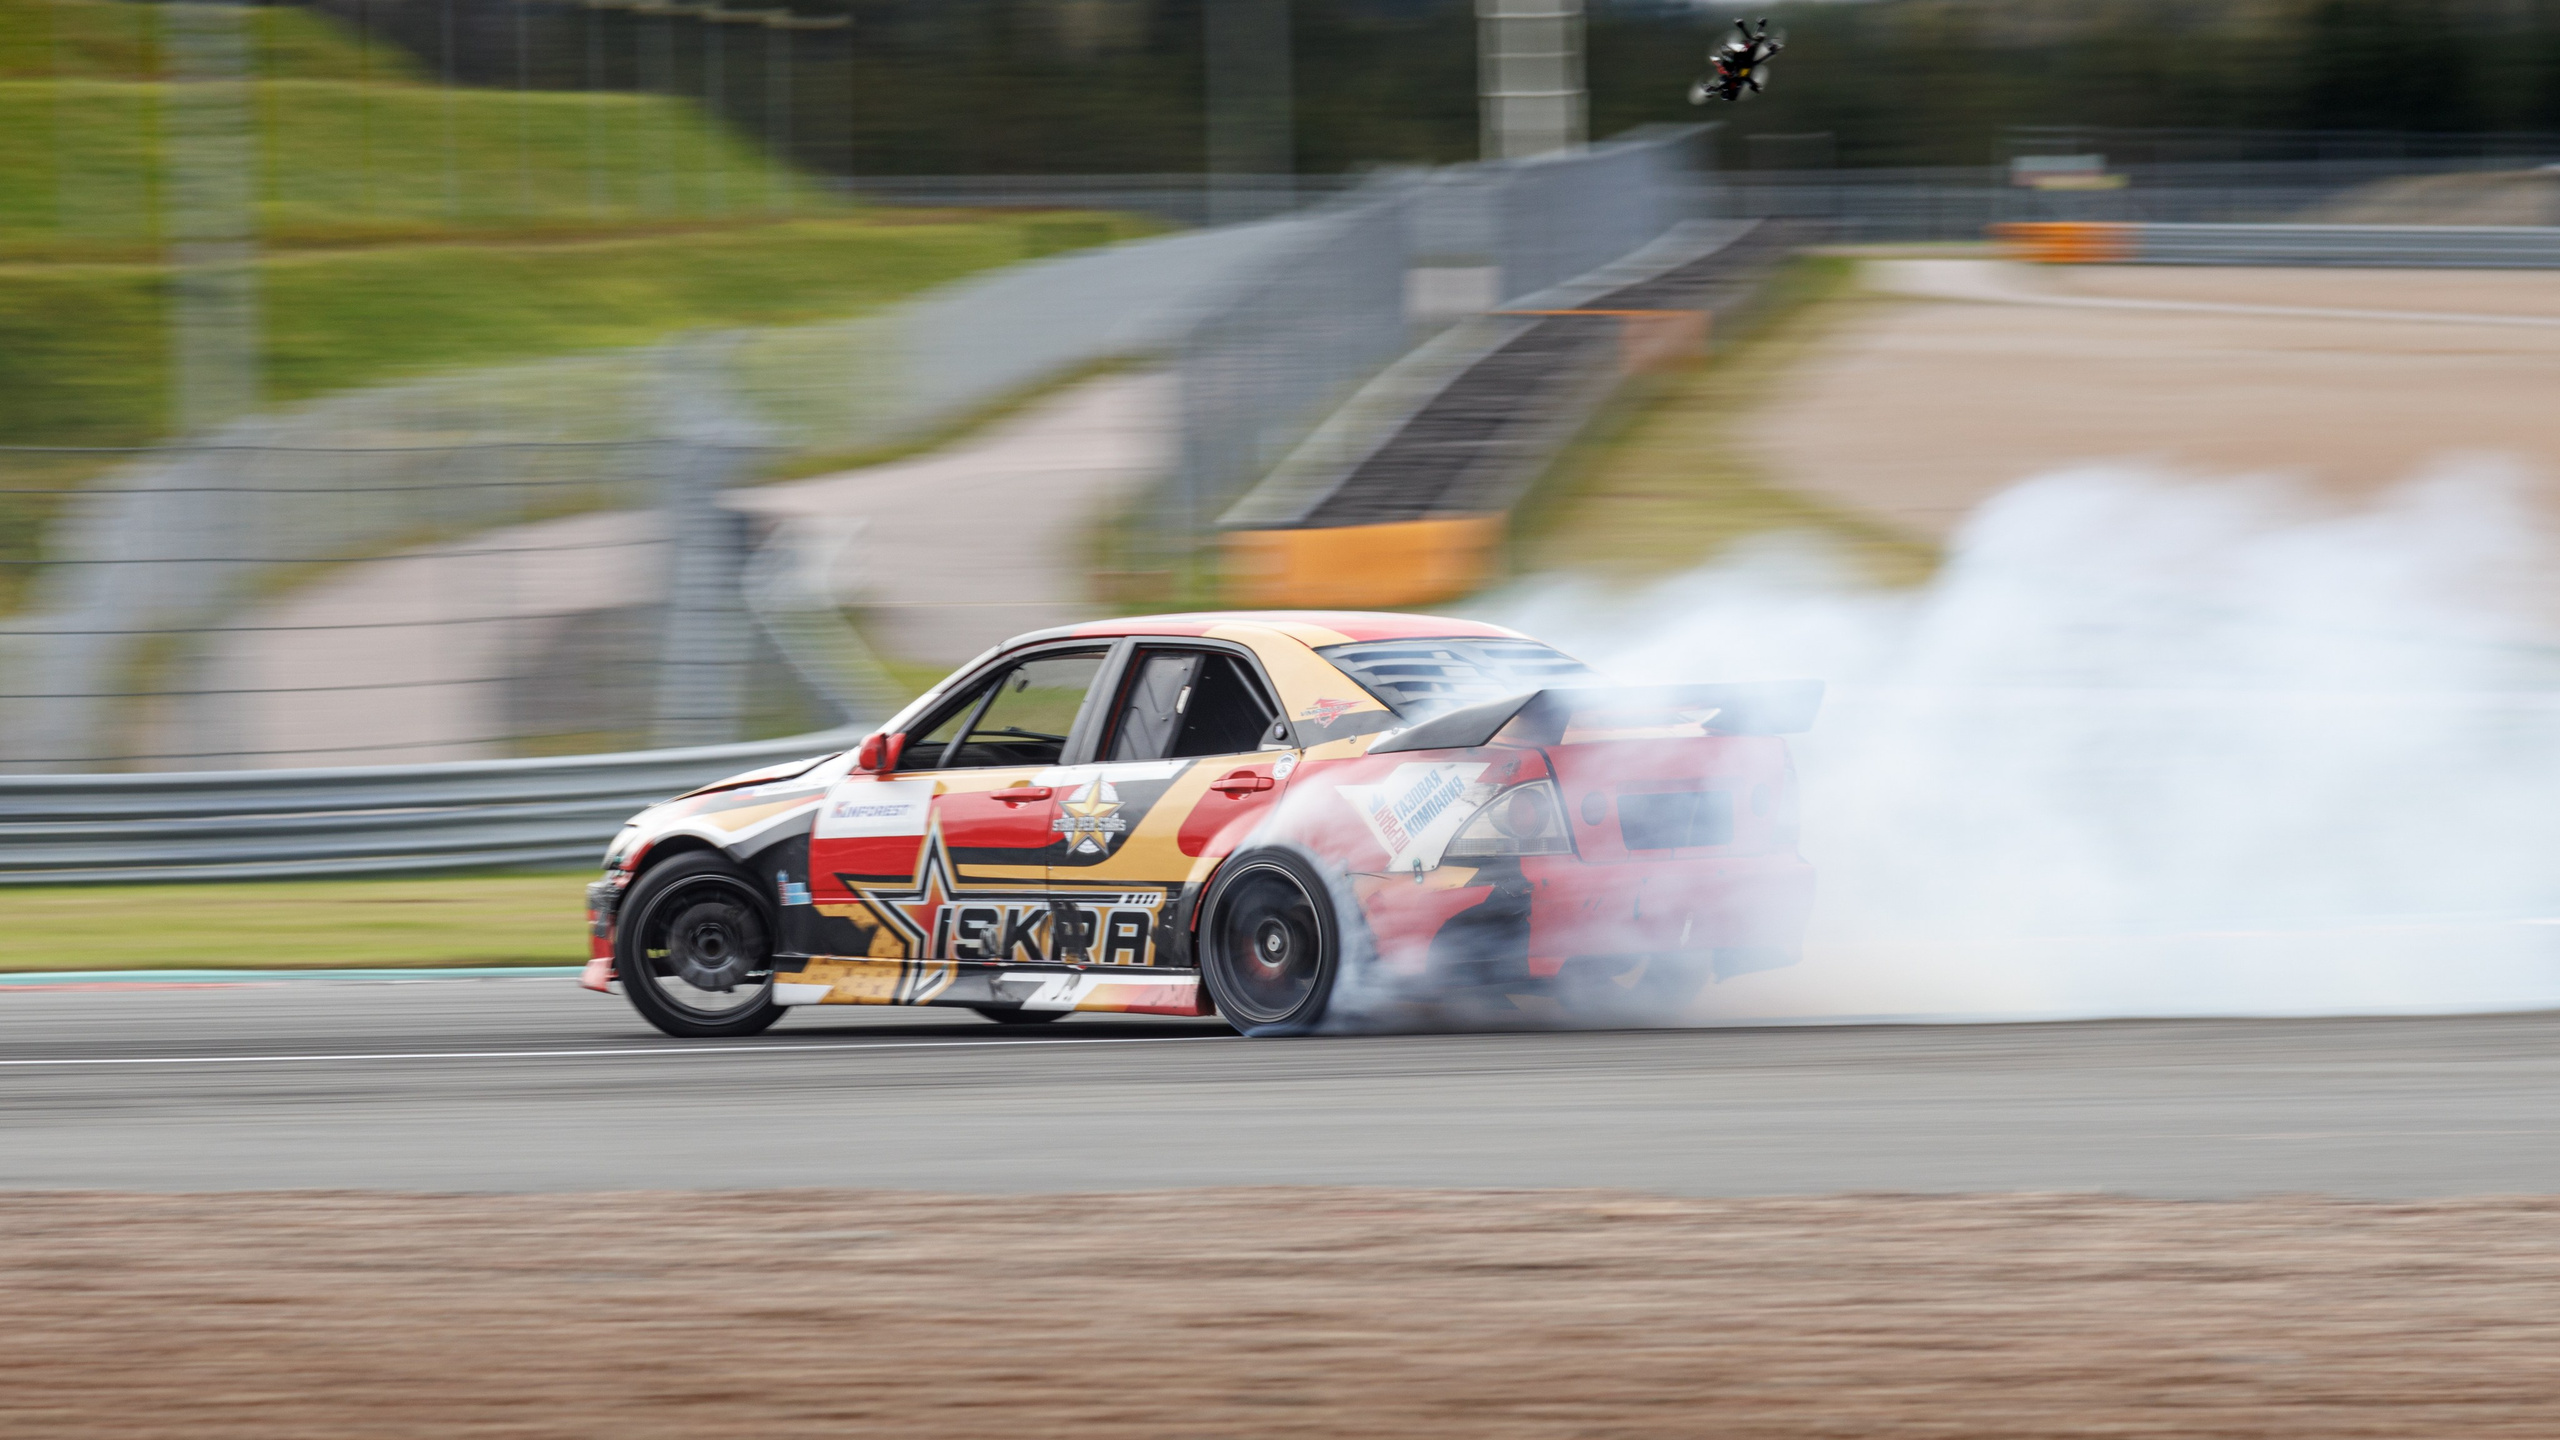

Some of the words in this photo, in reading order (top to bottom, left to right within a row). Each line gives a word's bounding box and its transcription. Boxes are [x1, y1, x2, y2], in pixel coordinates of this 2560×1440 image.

[1393, 769, 1442, 821] ГАЗОВАЯ
[1404, 775, 1465, 838] КОМПАНИЯ
[1374, 805, 1411, 855] ПЕРВАЯ
[933, 905, 1150, 965] ISKRA
